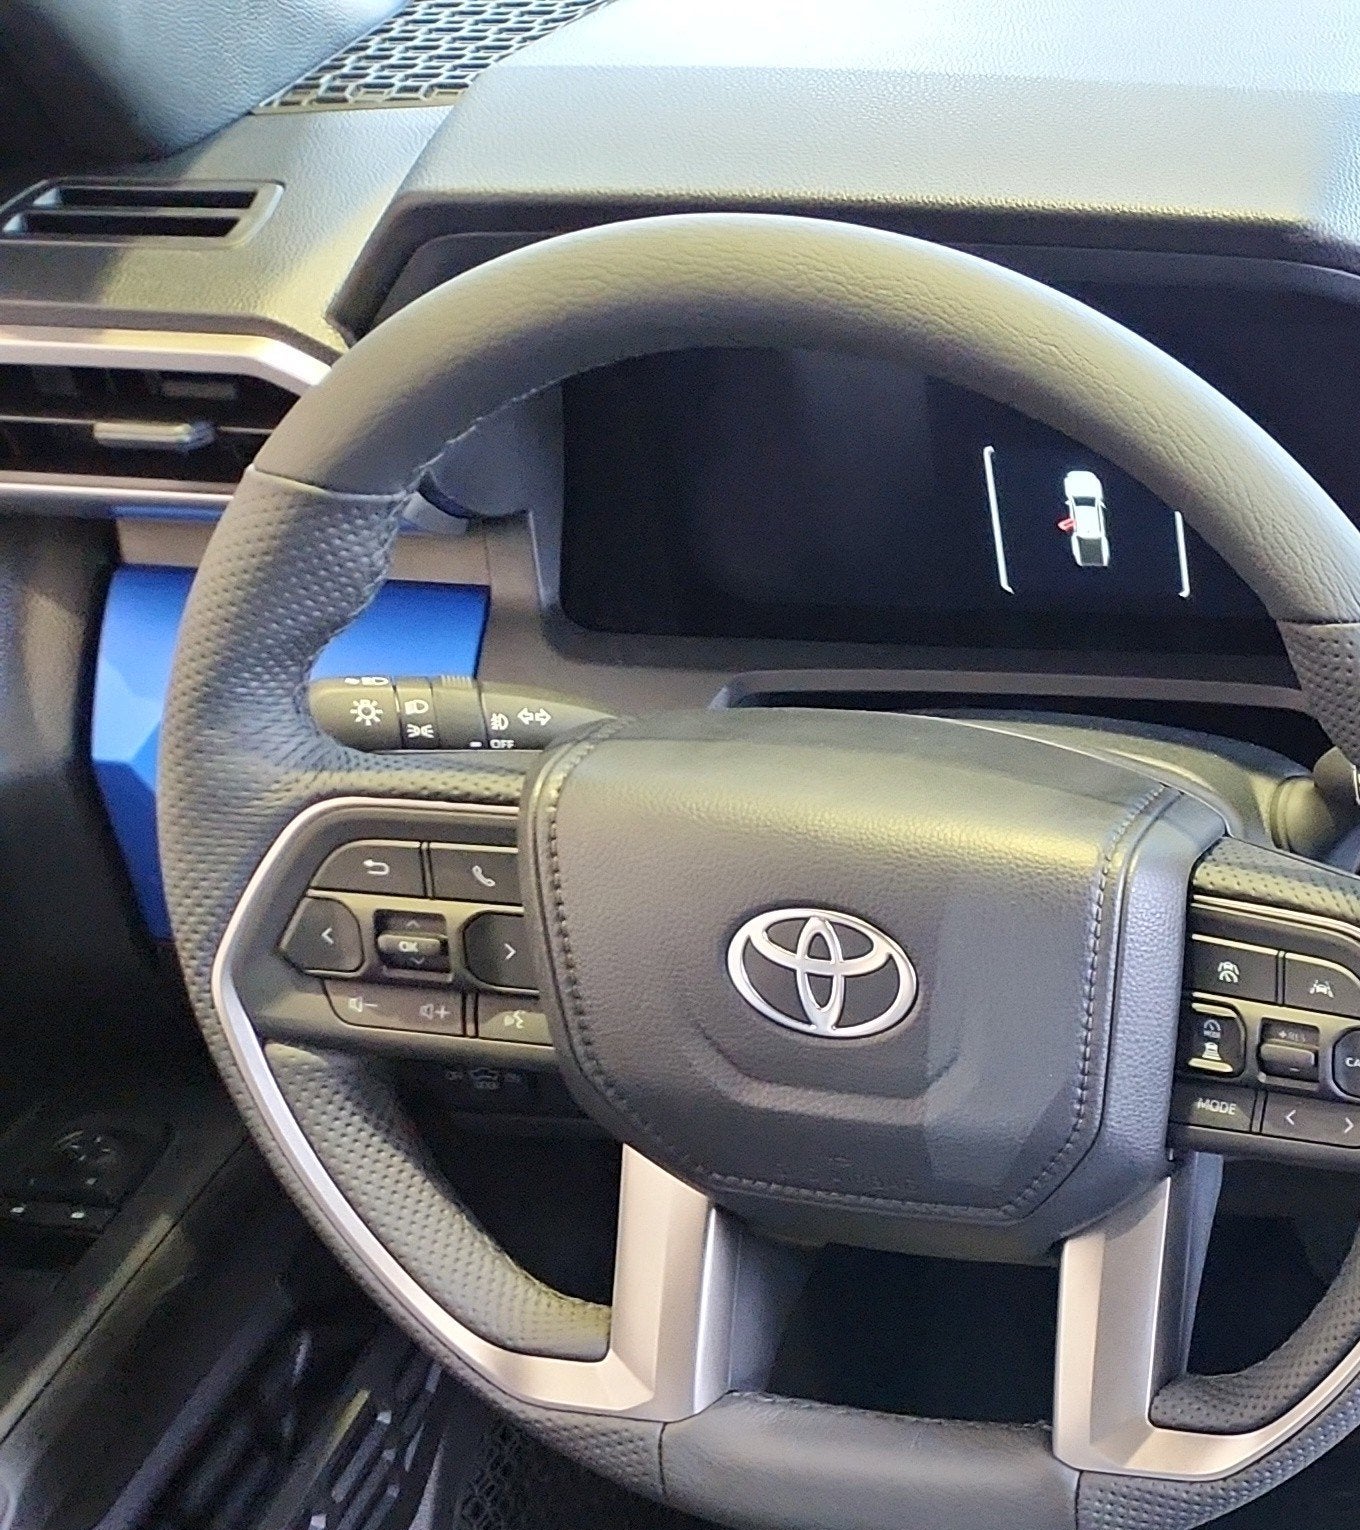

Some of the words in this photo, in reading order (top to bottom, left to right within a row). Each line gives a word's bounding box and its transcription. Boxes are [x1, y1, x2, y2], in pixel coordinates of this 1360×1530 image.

[489, 738, 515, 749] OFF
[398, 940, 419, 952] OK
[1195, 1097, 1237, 1116] MODE
